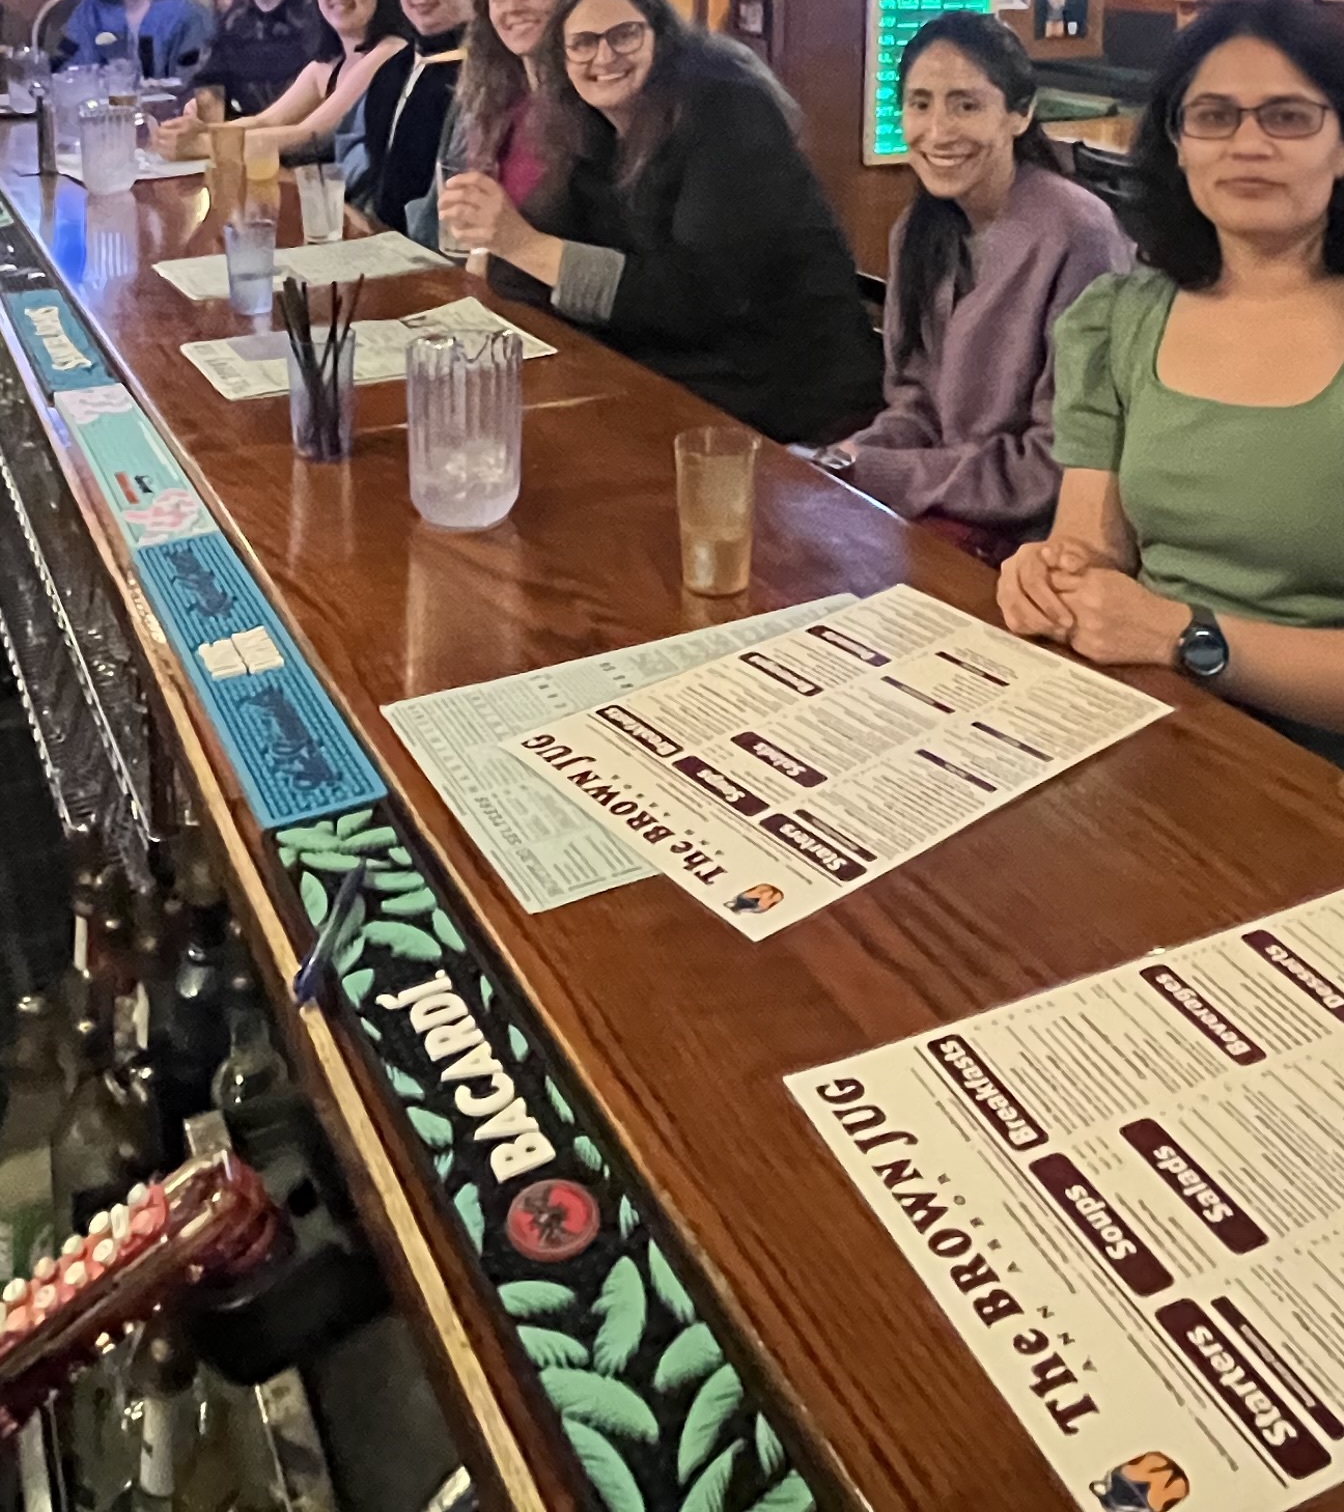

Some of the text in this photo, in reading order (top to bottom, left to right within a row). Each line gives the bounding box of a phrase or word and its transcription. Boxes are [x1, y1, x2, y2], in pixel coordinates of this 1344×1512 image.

[521, 735, 596, 771] JUG
[567, 770, 675, 844] BROWN
[670, 841, 728, 886] The
[1156, 973, 1251, 1056] Beverages
[940, 1039, 1038, 1146] Breakfasts
[1065, 1185, 1137, 1260] Soups
[1153, 1146, 1233, 1223] Salads
[816, 1079, 1099, 1435] The BROWN JUG
[1187, 1326, 1298, 1446] Starters
